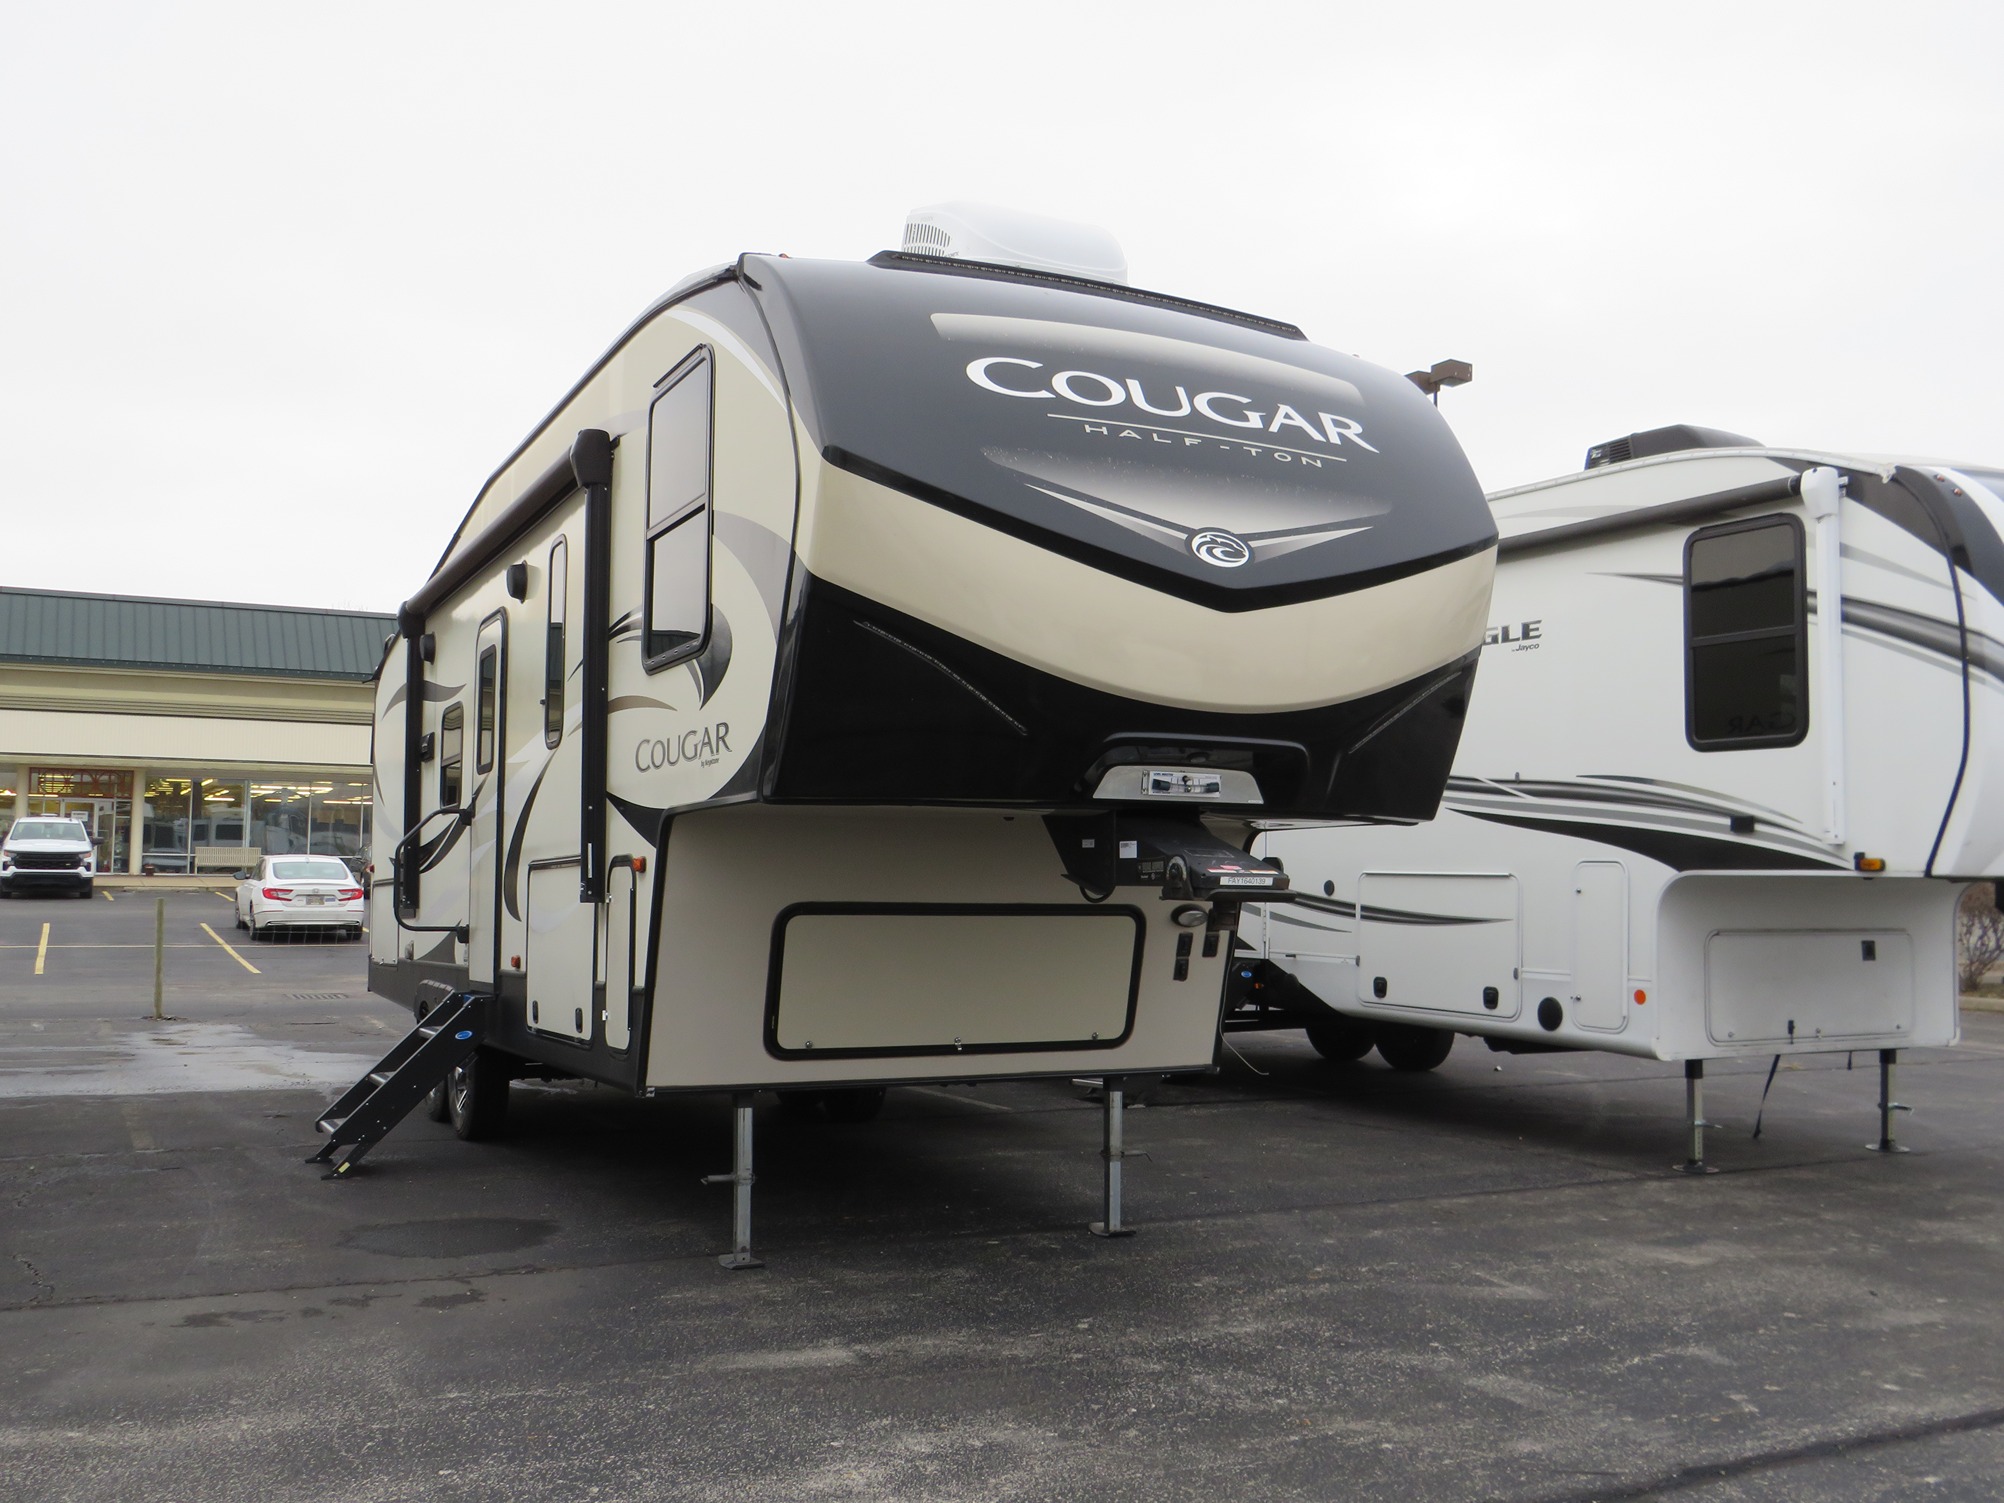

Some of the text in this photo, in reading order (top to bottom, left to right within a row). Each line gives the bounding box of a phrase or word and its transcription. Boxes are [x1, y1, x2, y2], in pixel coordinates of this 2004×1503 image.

[966, 356, 1380, 453] COUGAR
[1515, 643, 1540, 652] Jayco
[635, 721, 733, 773] COUGAR
